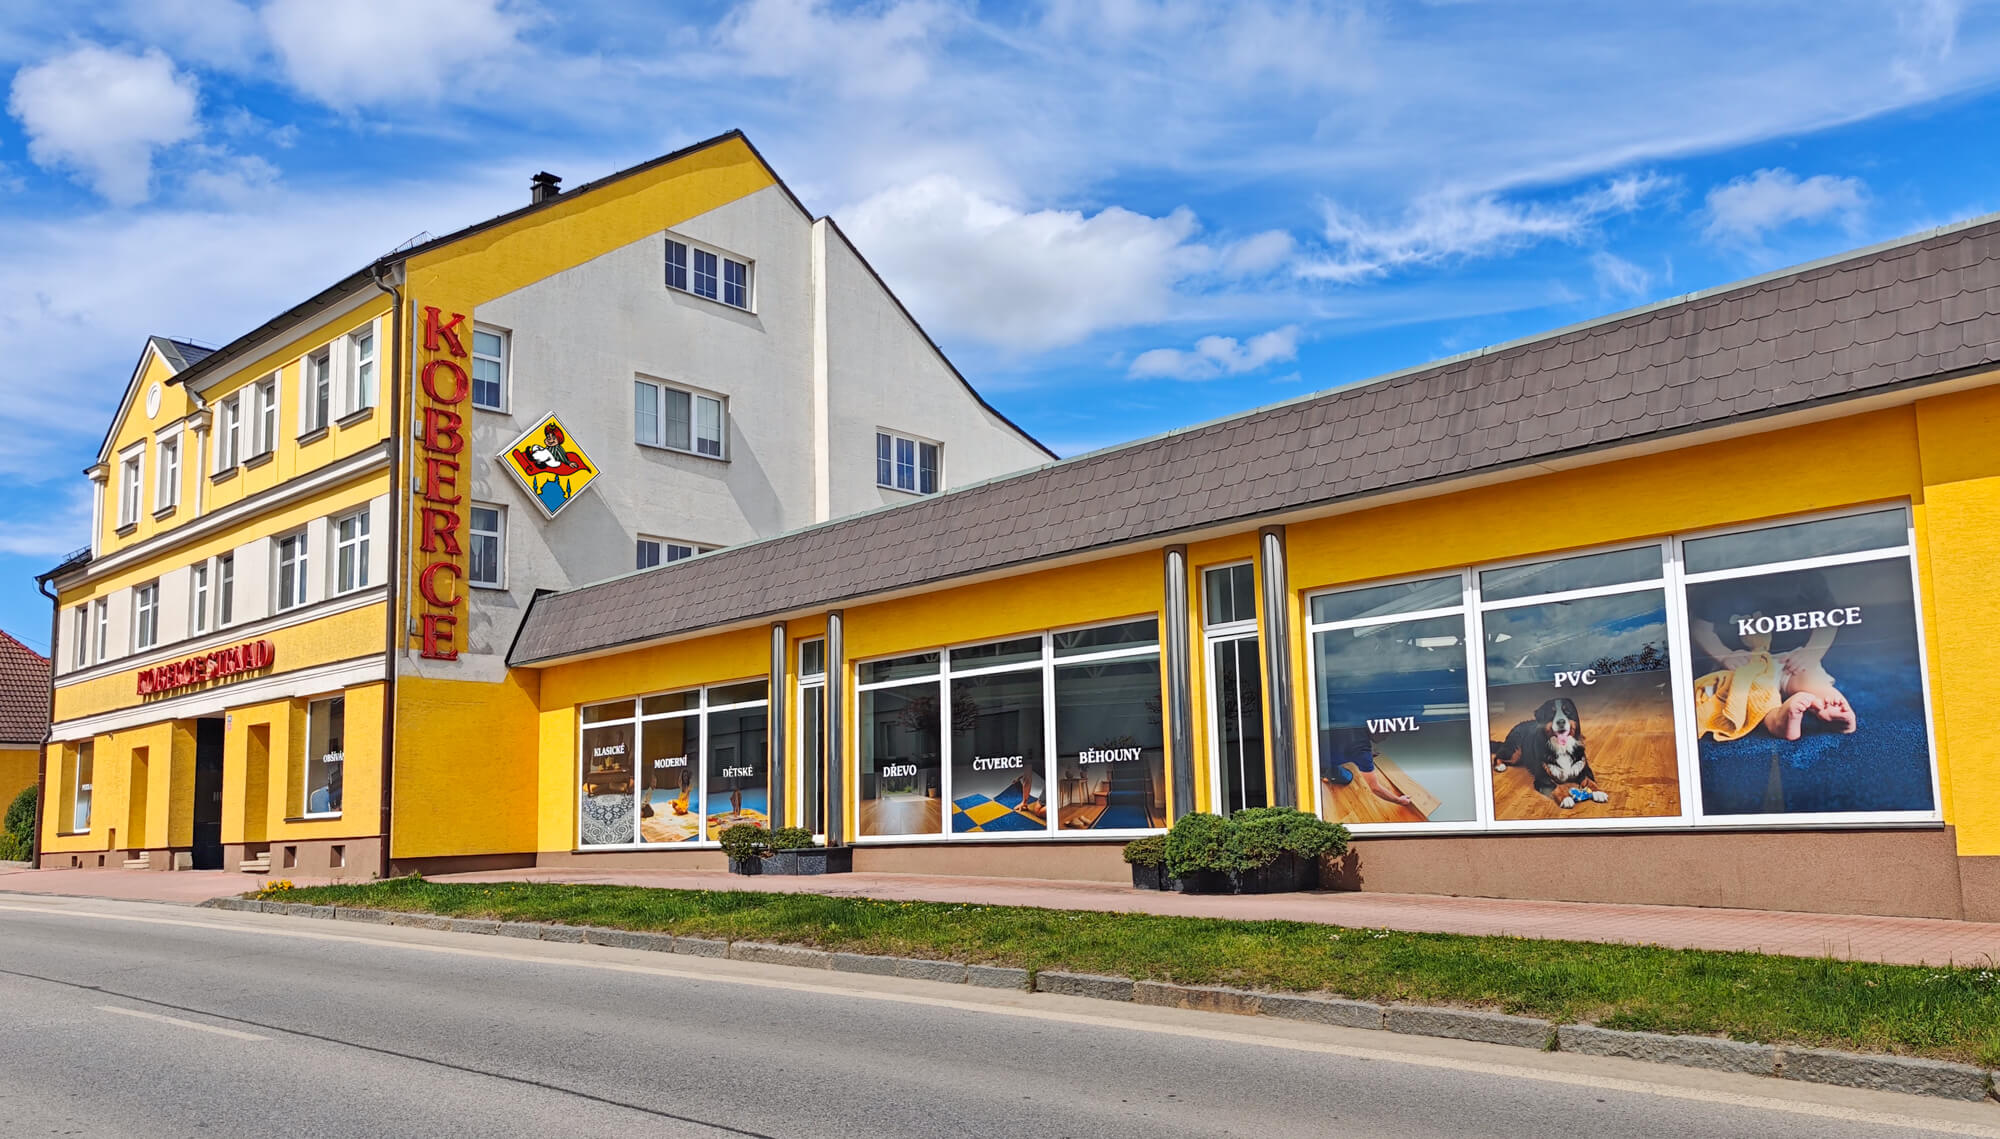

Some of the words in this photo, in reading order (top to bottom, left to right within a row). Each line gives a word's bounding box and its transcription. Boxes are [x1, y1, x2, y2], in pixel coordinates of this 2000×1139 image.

[420, 306, 469, 661] KOBERCE
[1737, 606, 1862, 636] KOBERCE
[1553, 668, 1596, 688] PVC
[1366, 715, 1419, 734] VINYL
[593, 744, 625, 757] KLASICKÉ
[1079, 747, 1142, 764] BĚHOUNY
[654, 754, 688, 769] MODERNÍ
[972, 756, 1024, 772] ČTVERCE
[722, 765, 754, 778] DĚTSKÉ
[882, 763, 917, 778] DŘEVO
